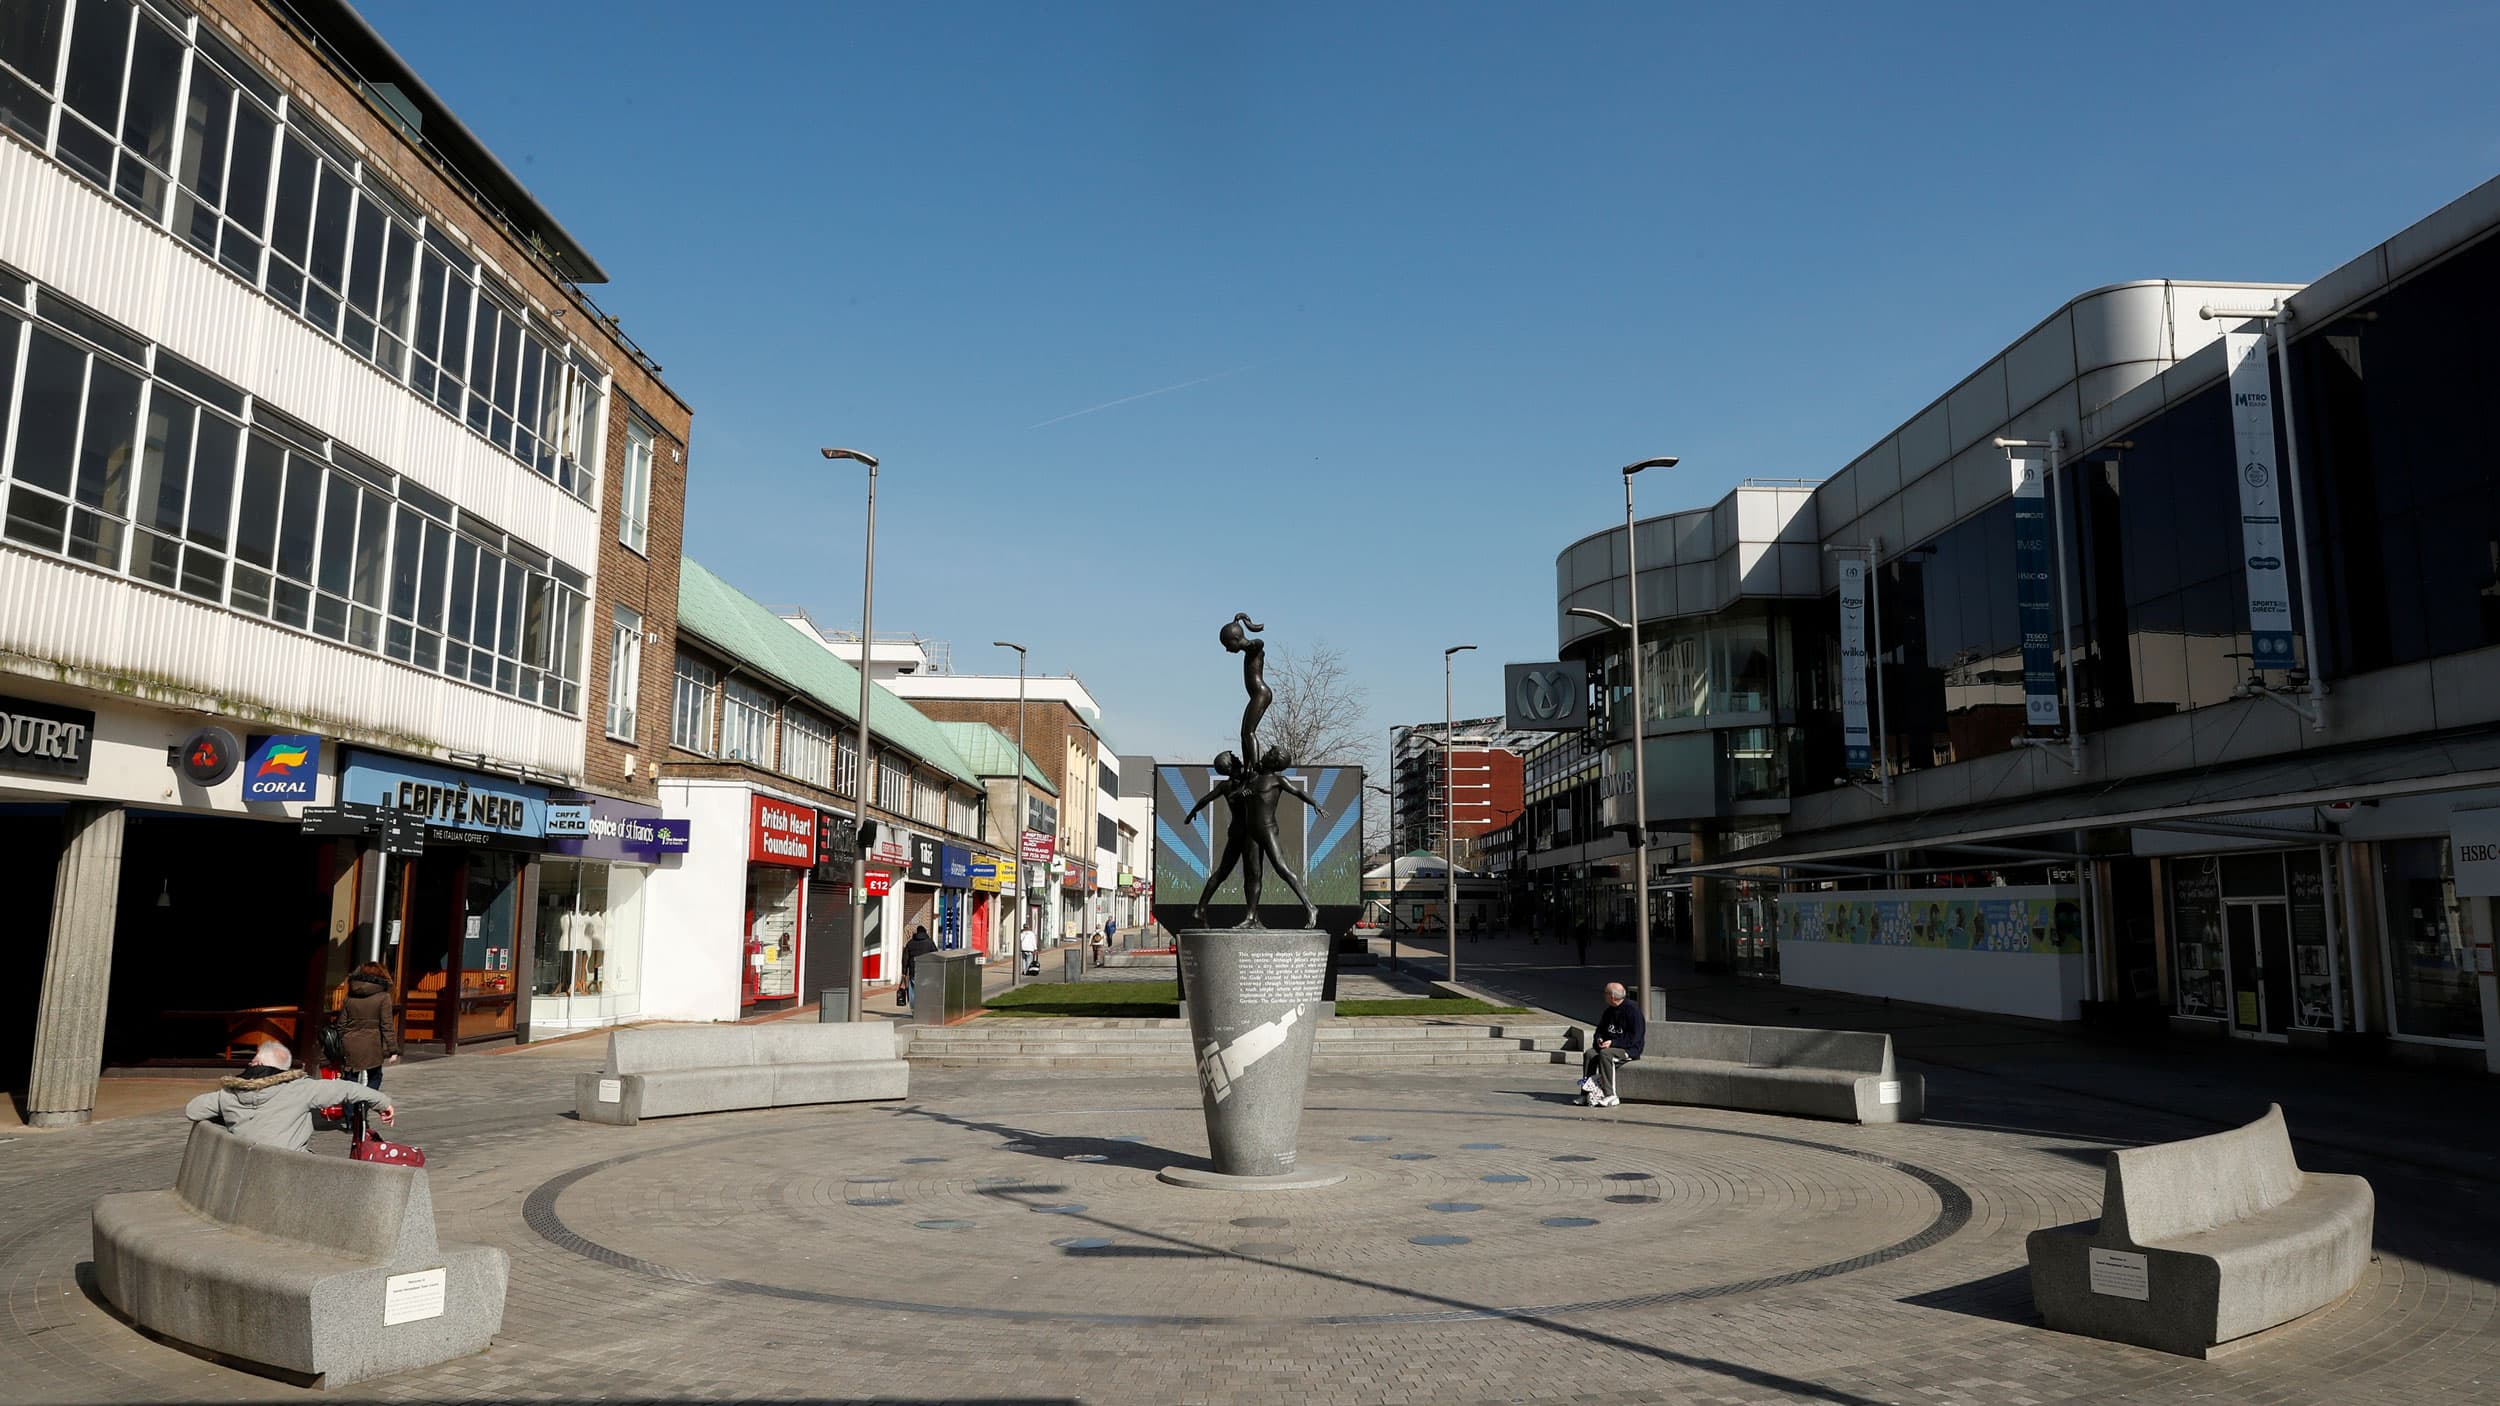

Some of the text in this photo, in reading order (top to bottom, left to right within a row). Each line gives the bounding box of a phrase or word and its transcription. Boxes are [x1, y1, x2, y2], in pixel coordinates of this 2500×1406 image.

[1841, 597, 1863, 606] Argos
[1842, 647, 1865, 656] wilko
[252, 781, 307, 793] CORAL
[469, 791, 524, 831] NERO
[548, 820, 586, 830] NERO
[588, 815, 617, 841] ospice
[761, 806, 811, 837] British Heart
[433, 829, 442, 839] THE
[443, 830, 463, 841] ITALIAN
[464, 832, 482, 843] COFFEE
[763, 831, 808, 858] Foundation
[2459, 844, 2497, 862] HSBC
[870, 880, 889, 890] £12
